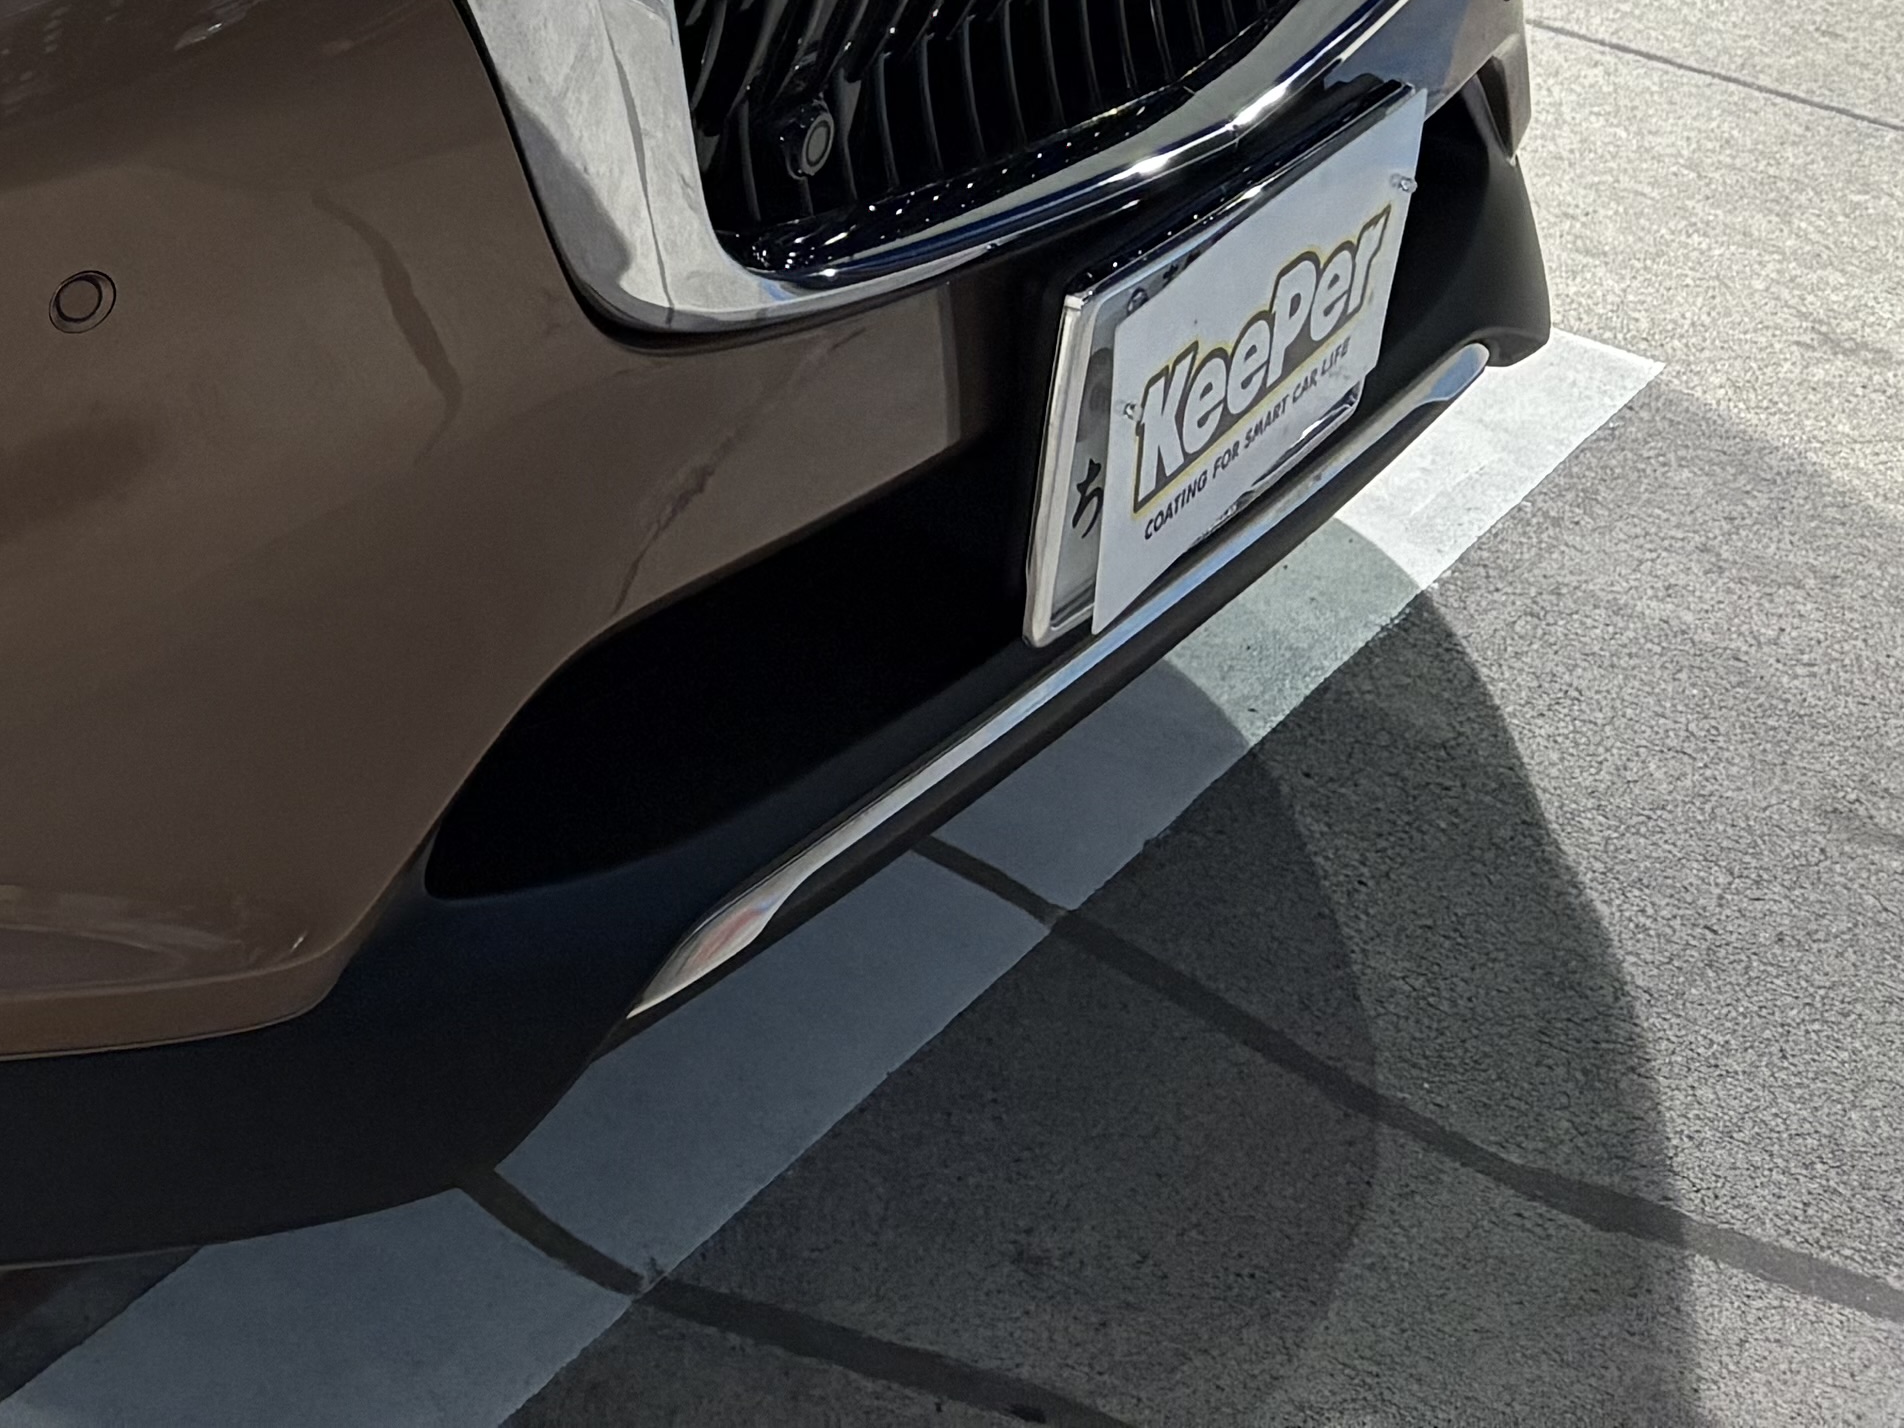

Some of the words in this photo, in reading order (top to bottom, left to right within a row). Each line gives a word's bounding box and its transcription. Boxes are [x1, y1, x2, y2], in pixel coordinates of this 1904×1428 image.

[1133, 204, 1392, 515] KeePer
[1144, 470, 1208, 540] COATING
[1212, 440, 1241, 480] FOR
[1244, 394, 1290, 449] SMART
[1292, 367, 1319, 405] CAR
[1320, 336, 1352, 383] LIFE
